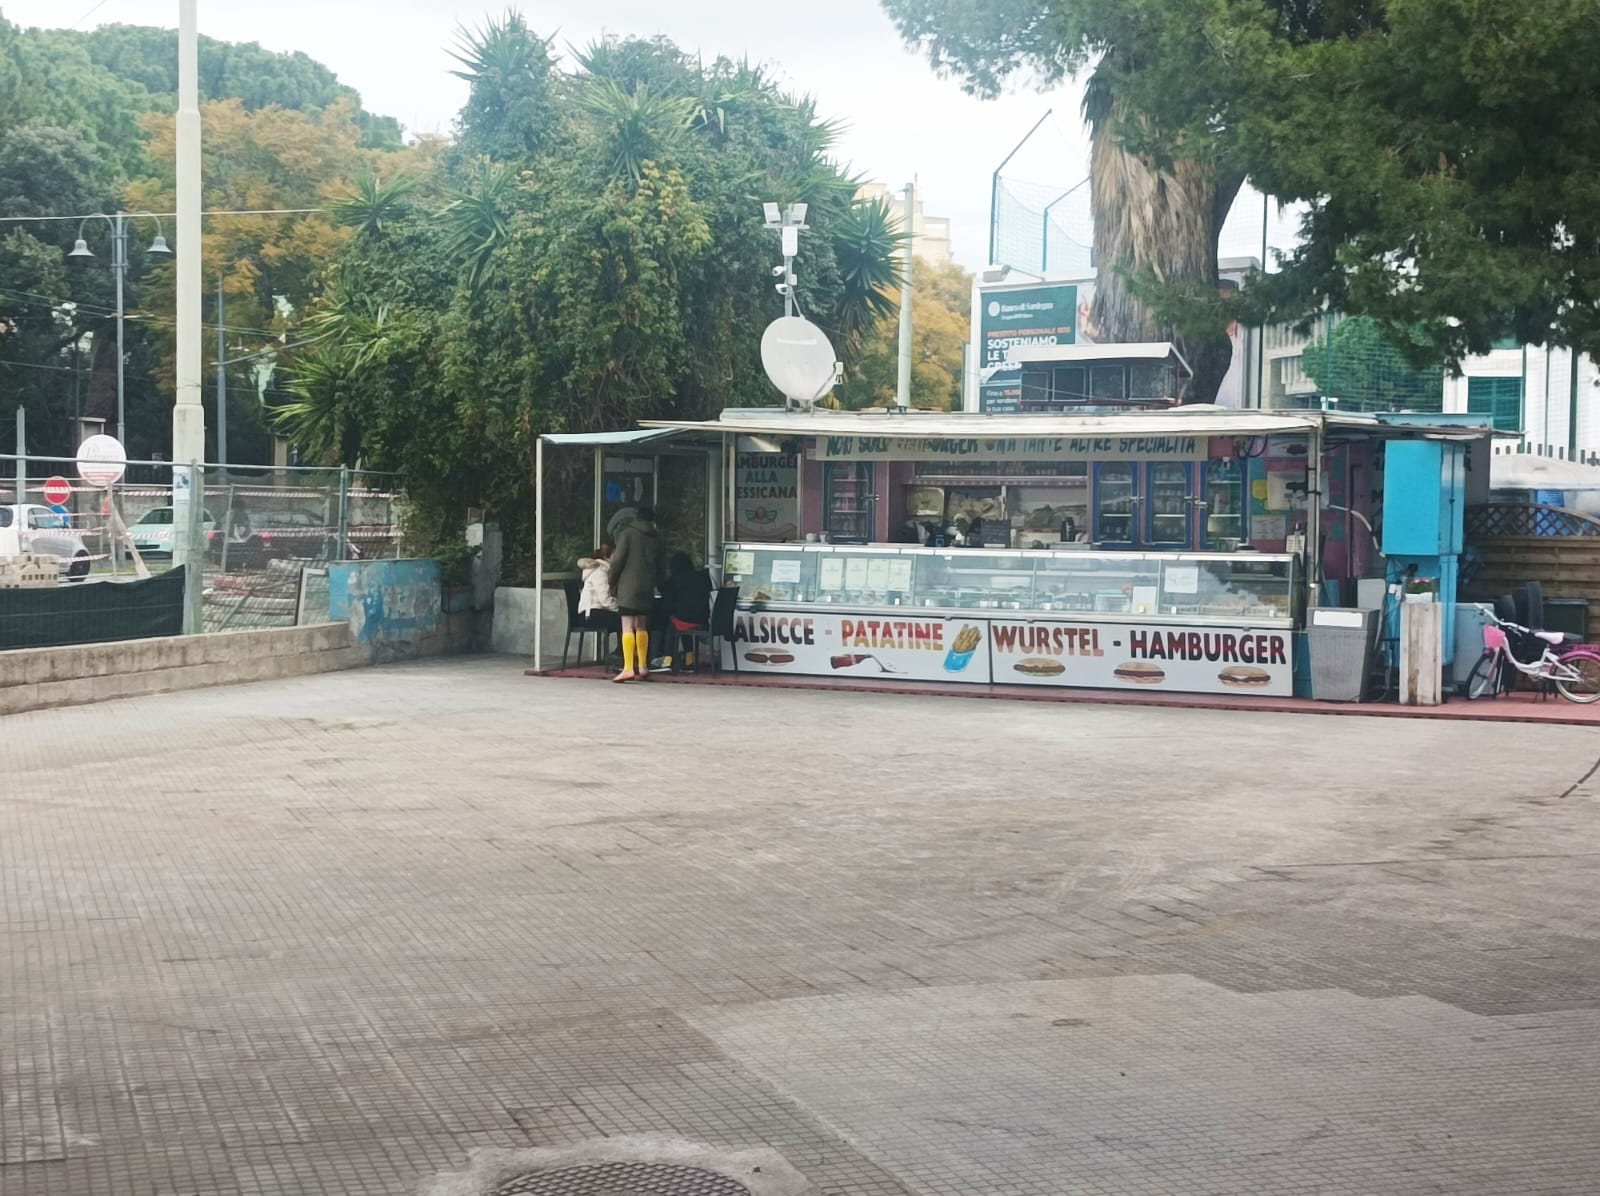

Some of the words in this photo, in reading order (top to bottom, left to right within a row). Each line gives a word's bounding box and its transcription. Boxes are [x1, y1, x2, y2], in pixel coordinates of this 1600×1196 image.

[987, 336, 1057, 349] SOSTENIAMO
[987, 350, 1000, 361] LE
[745, 470, 778, 483] ALLA
[727, 486, 798, 499] ESSICANA
[725, 616, 815, 645] ALSICCE
[841, 619, 944, 651] PATATINE
[992, 625, 1104, 657] WURSTEL
[1130, 630, 1287, 665] HAMBURGER
